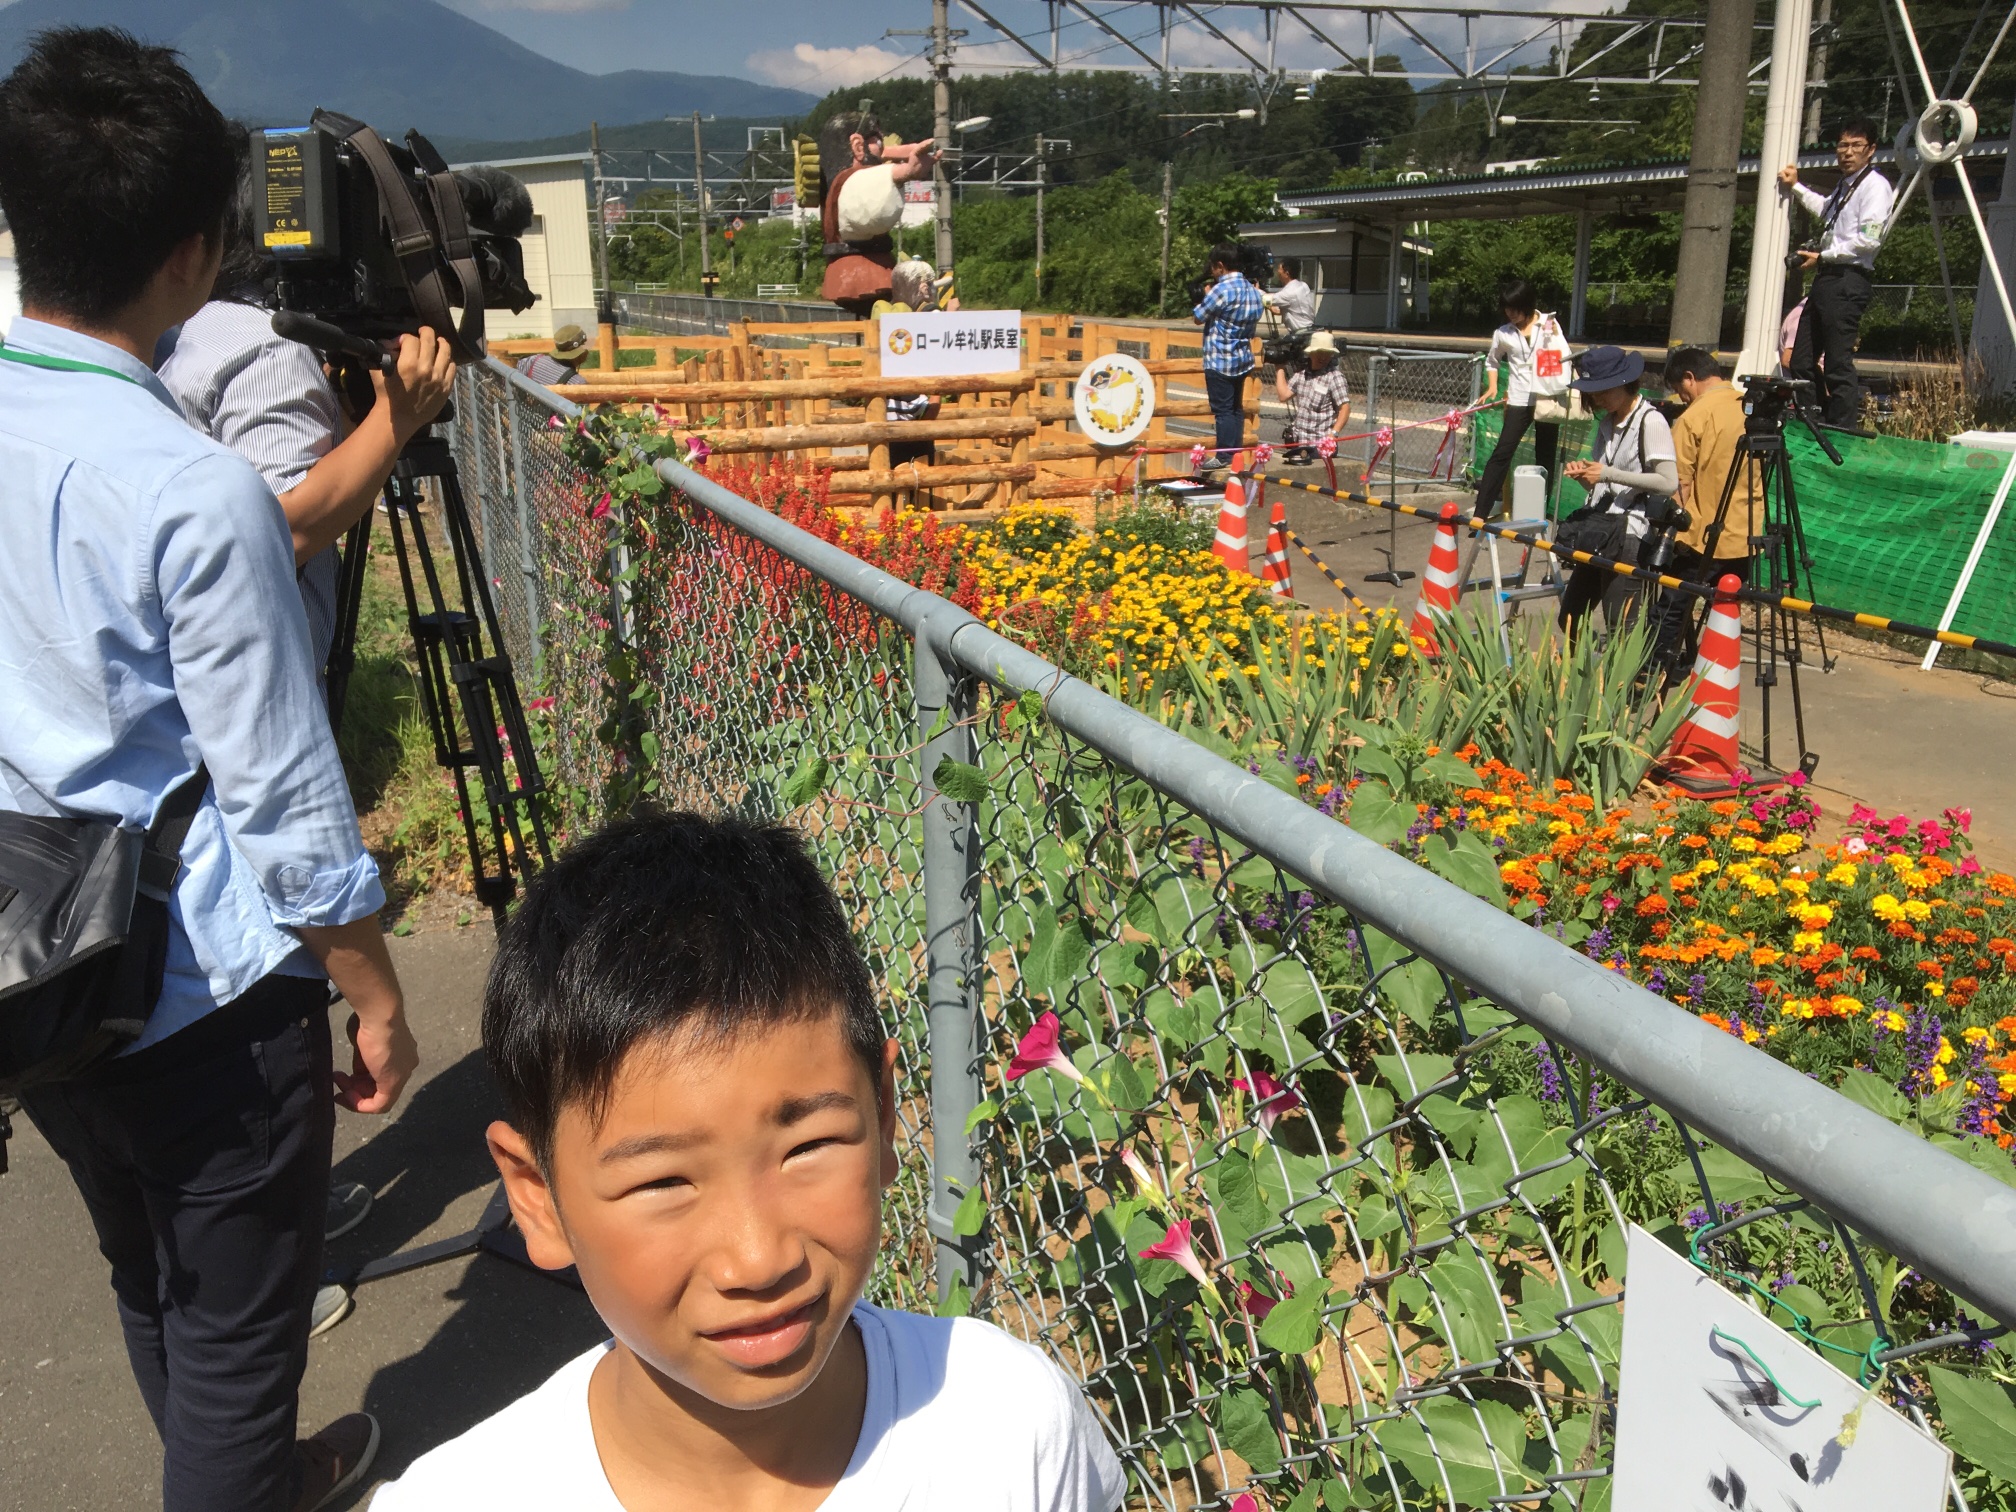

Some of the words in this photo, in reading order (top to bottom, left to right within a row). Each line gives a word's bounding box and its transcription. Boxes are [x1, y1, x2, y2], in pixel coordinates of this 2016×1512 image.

[916, 328, 1018, 350] ロール牟礼駅長室
